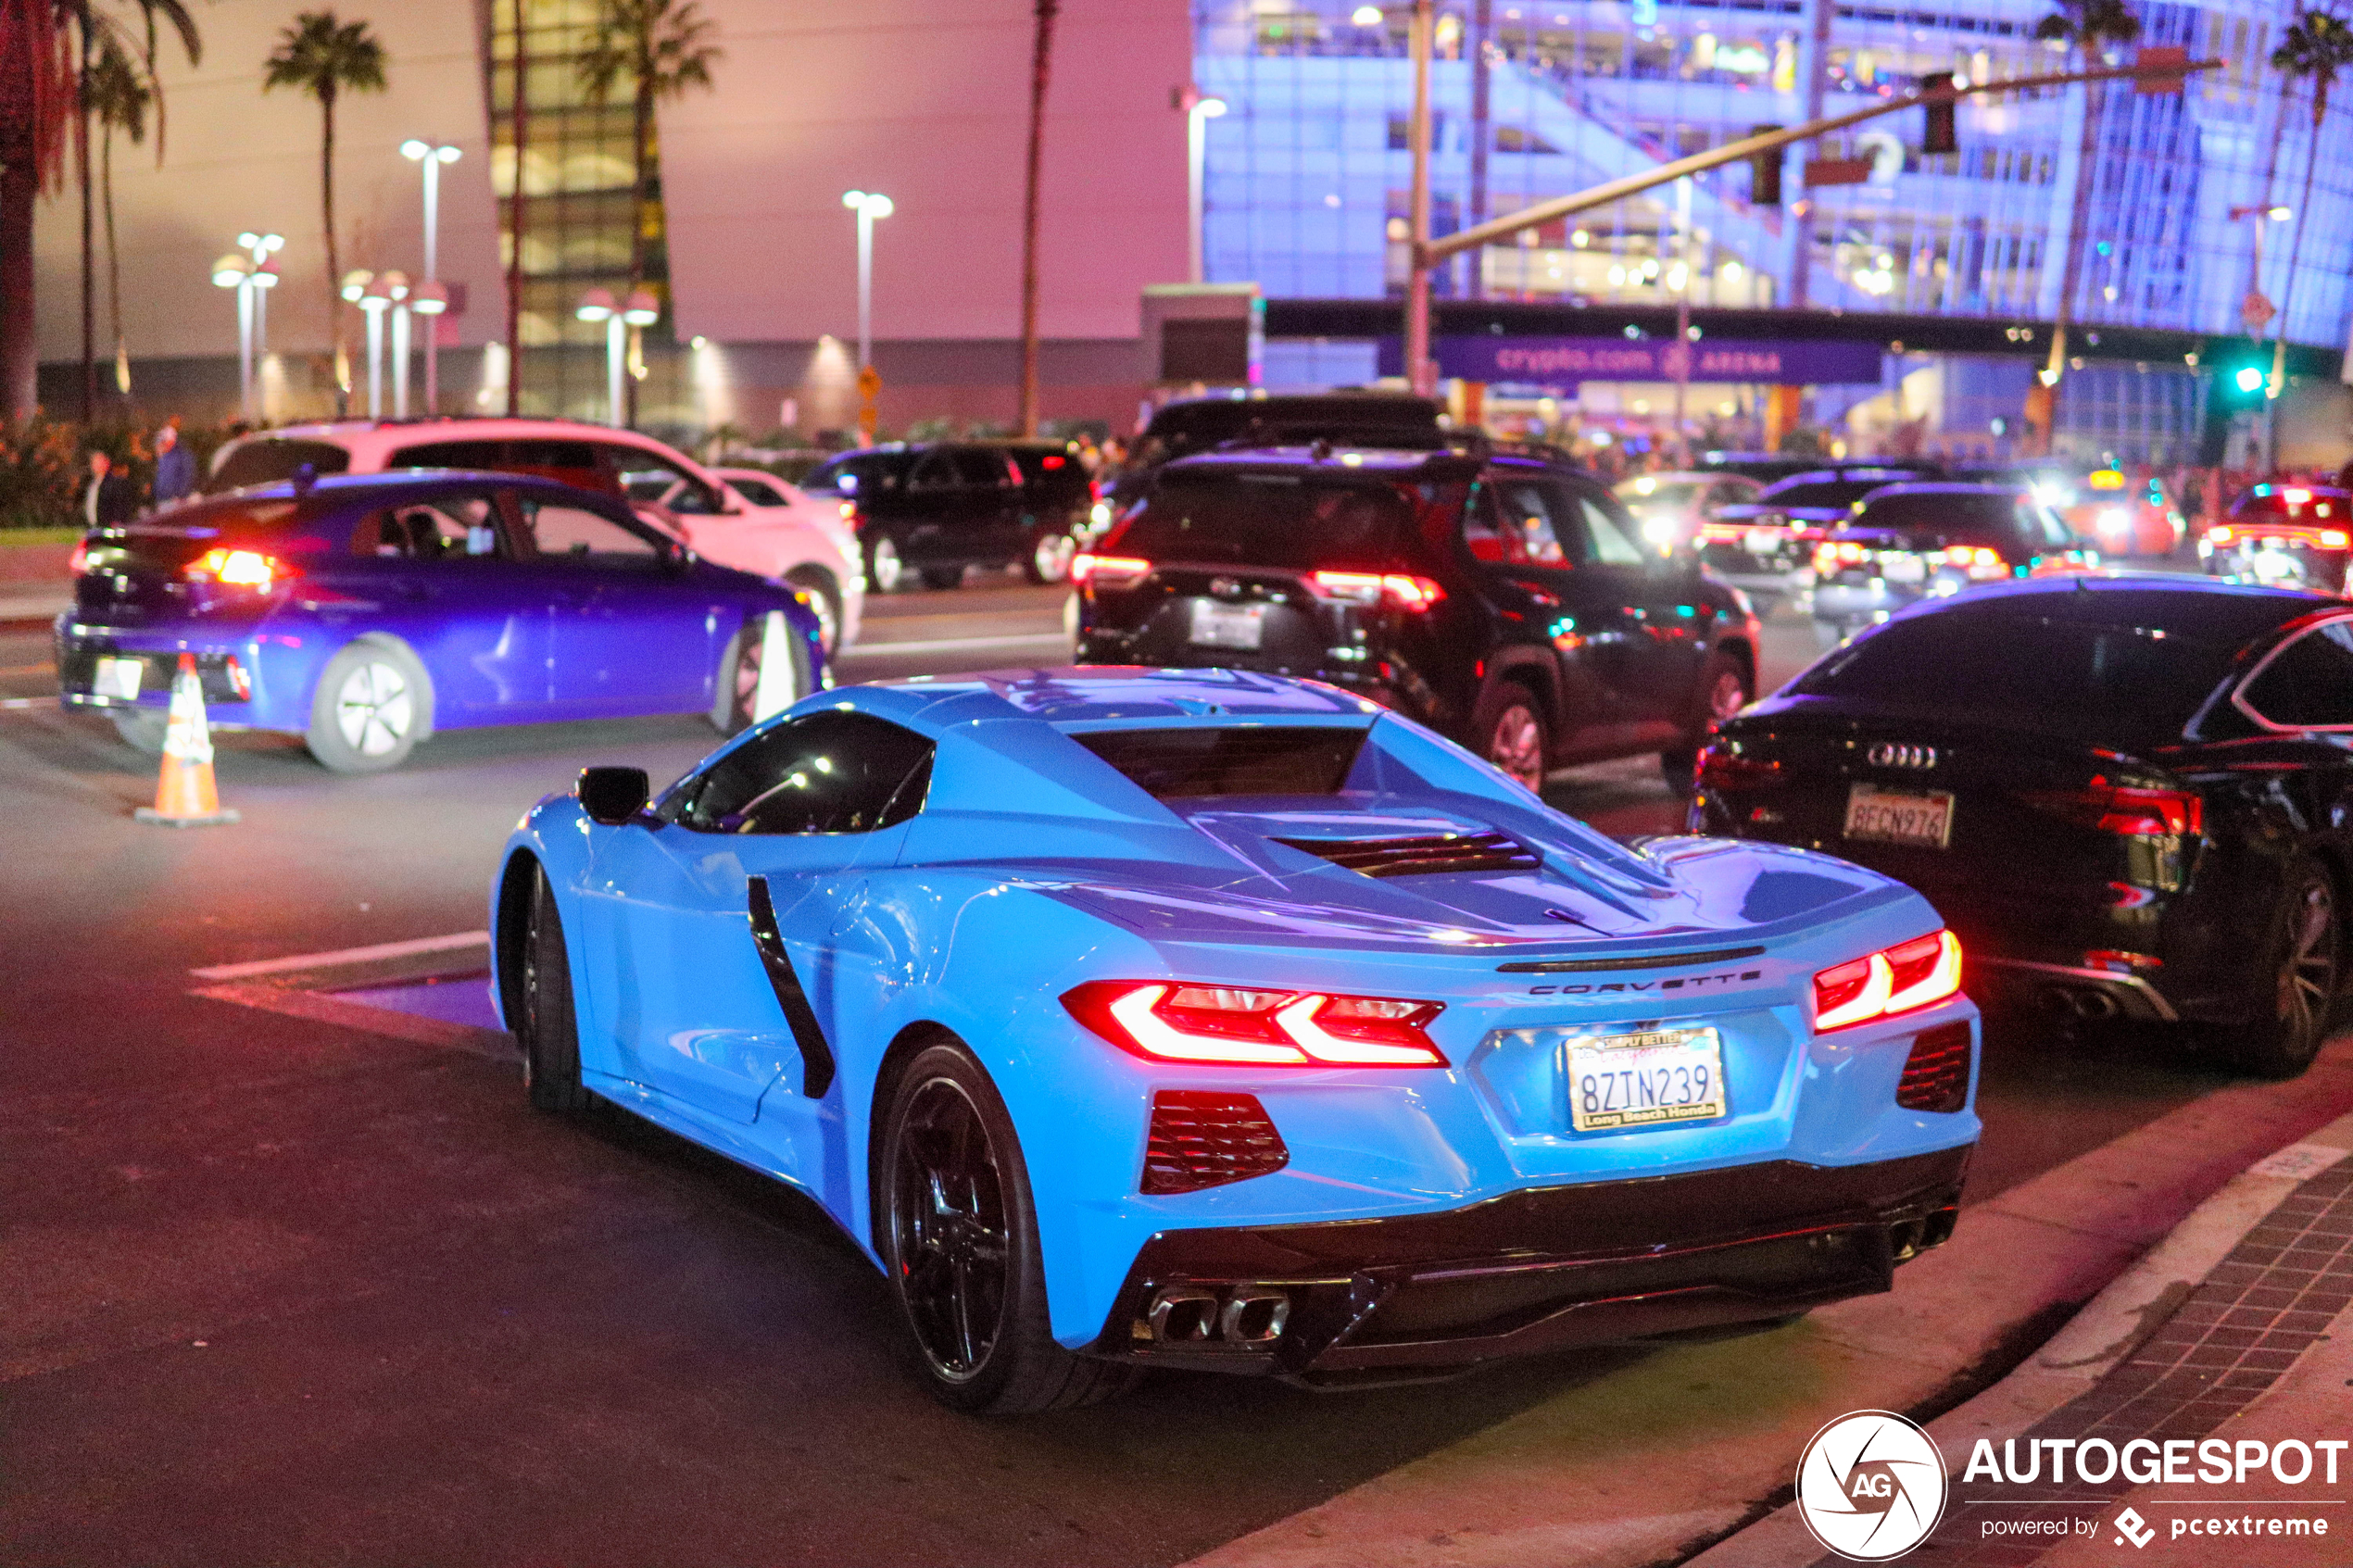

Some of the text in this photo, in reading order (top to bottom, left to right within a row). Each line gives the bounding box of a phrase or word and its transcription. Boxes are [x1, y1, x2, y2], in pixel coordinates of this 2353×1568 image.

[1529, 970, 1762, 996] CORVETTE
[1604, 1035, 1642, 1049] SIMPLY
[1642, 1031, 1681, 1047] BETTER
[1582, 1065, 1709, 1113] 8ZIN239
[1585, 1104, 1716, 1127] Long Beach Honda
